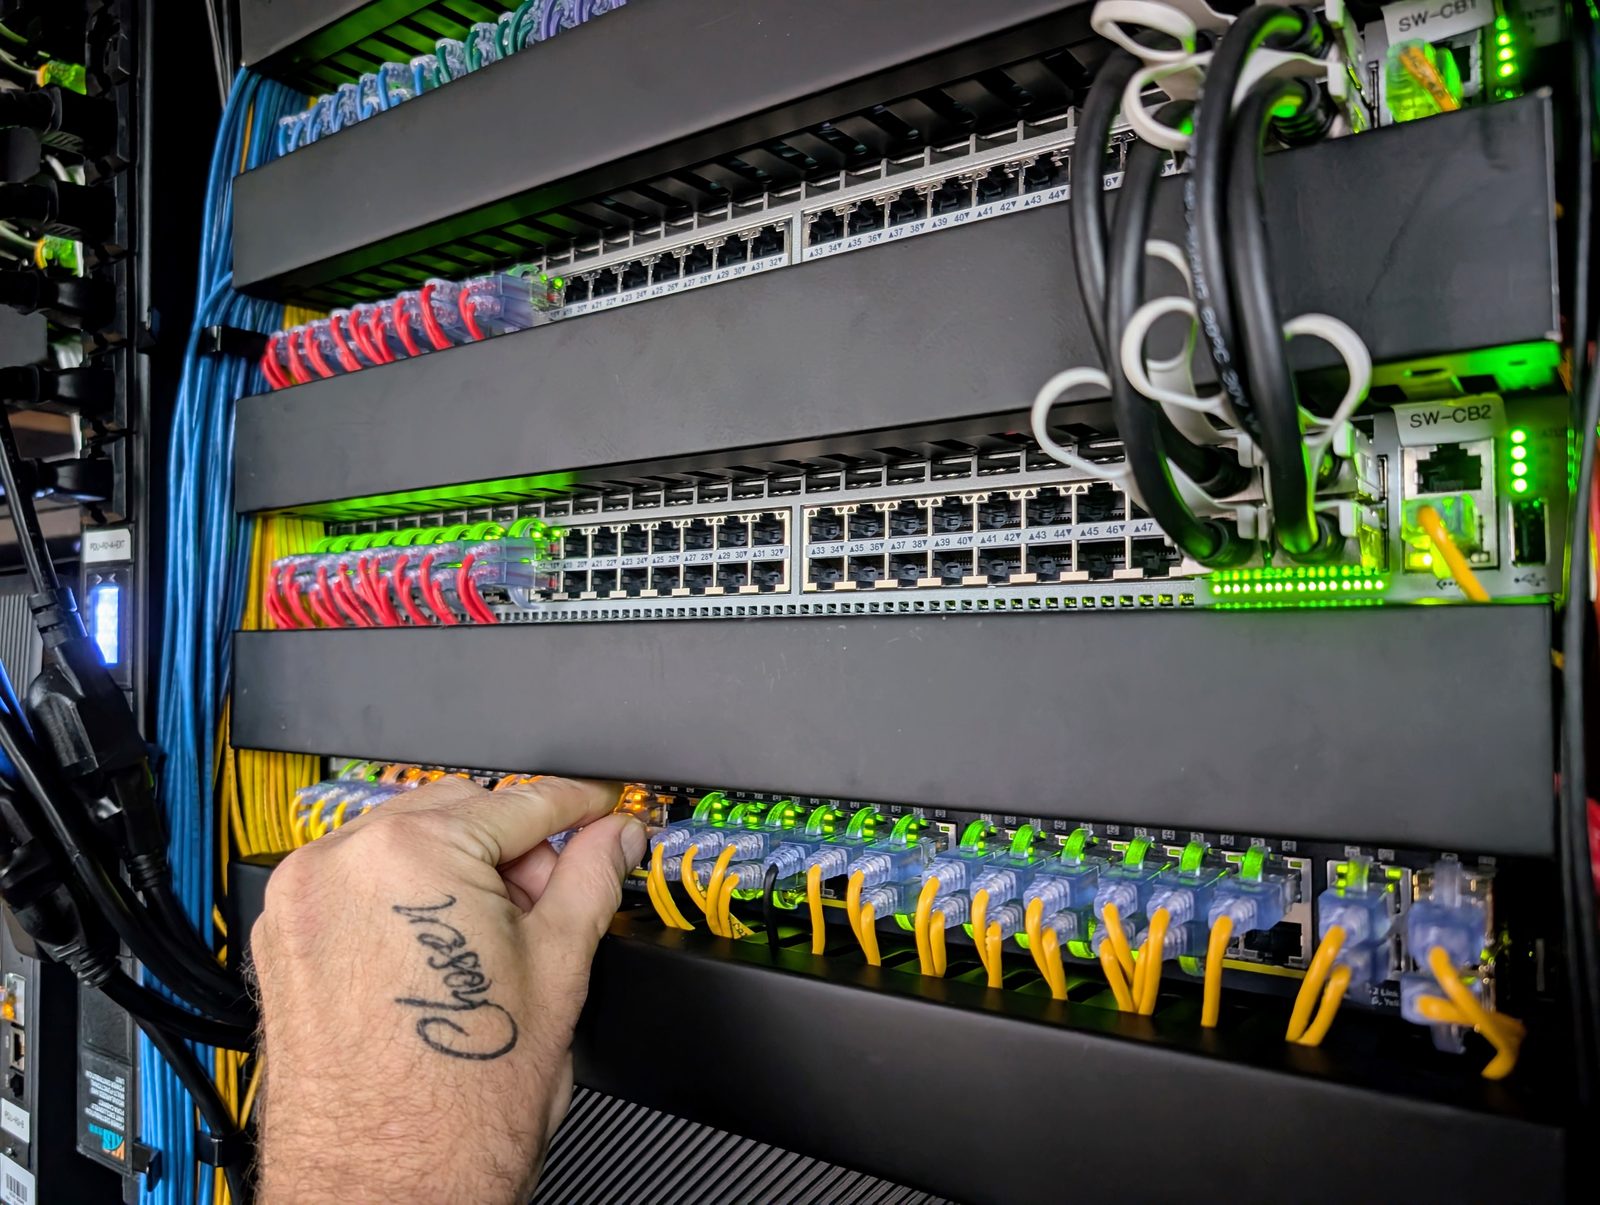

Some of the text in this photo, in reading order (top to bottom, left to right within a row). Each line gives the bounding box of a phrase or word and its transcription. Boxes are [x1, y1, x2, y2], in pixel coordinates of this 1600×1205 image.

[815, 248, 822, 256] 33
[829, 244, 837, 252] 34
[868, 235, 877, 243] 36
[894, 228, 903, 237] 37
[910, 224, 919, 233] 38
[938, 218, 947, 227] 39
[954, 214, 964, 222] 40
[983, 207, 992, 216] 41
[1000, 203, 1010, 212] 42
[1030, 196, 1041, 204] 43
[1049, 191, 1060, 200] 44
[1410, 405, 1492, 428] SW-CB2
[854, 544, 863, 552] 35
[896, 541, 906, 549] 37
[913, 540, 922, 548] 38
[940, 538, 950, 546] 39
[957, 537, 967, 545] 40
[1036, 531, 1046, 539] 43
[1054, 529, 1066, 537] 44
[1087, 527, 1098, 535] 45
[1106, 526, 1118, 534] 46
[1141, 523, 1153, 531] 47
